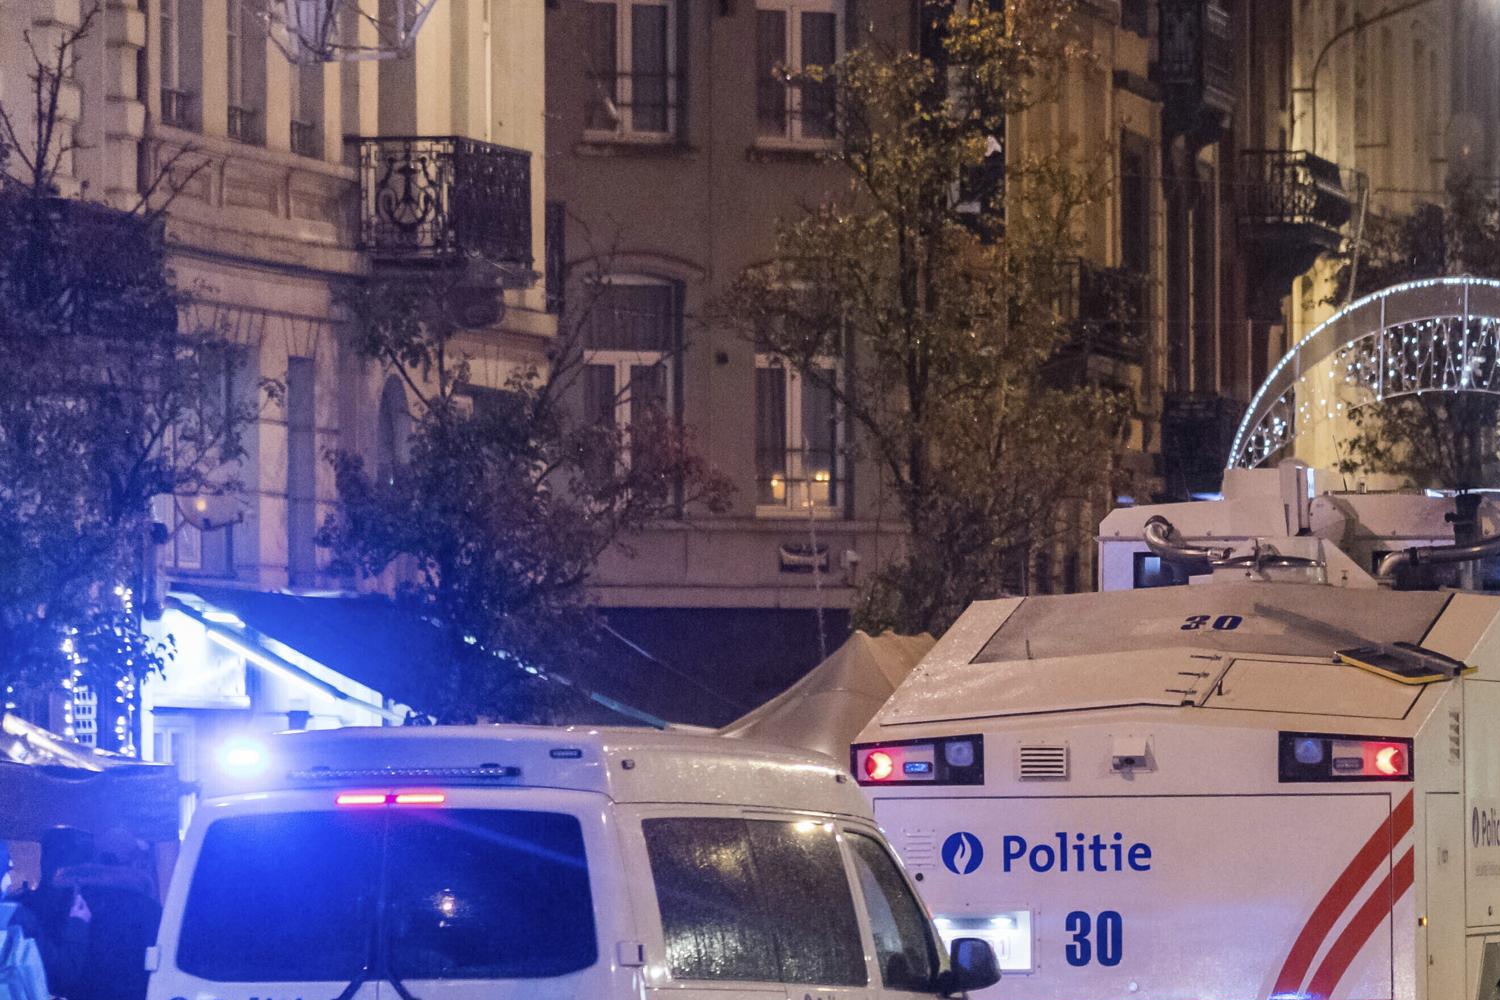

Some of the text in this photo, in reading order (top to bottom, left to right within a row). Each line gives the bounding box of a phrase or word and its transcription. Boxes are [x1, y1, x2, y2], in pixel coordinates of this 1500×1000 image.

[1180, 614, 1243, 630] 30
[1003, 832, 1152, 872] Politie
[1065, 910, 1123, 967] 30
